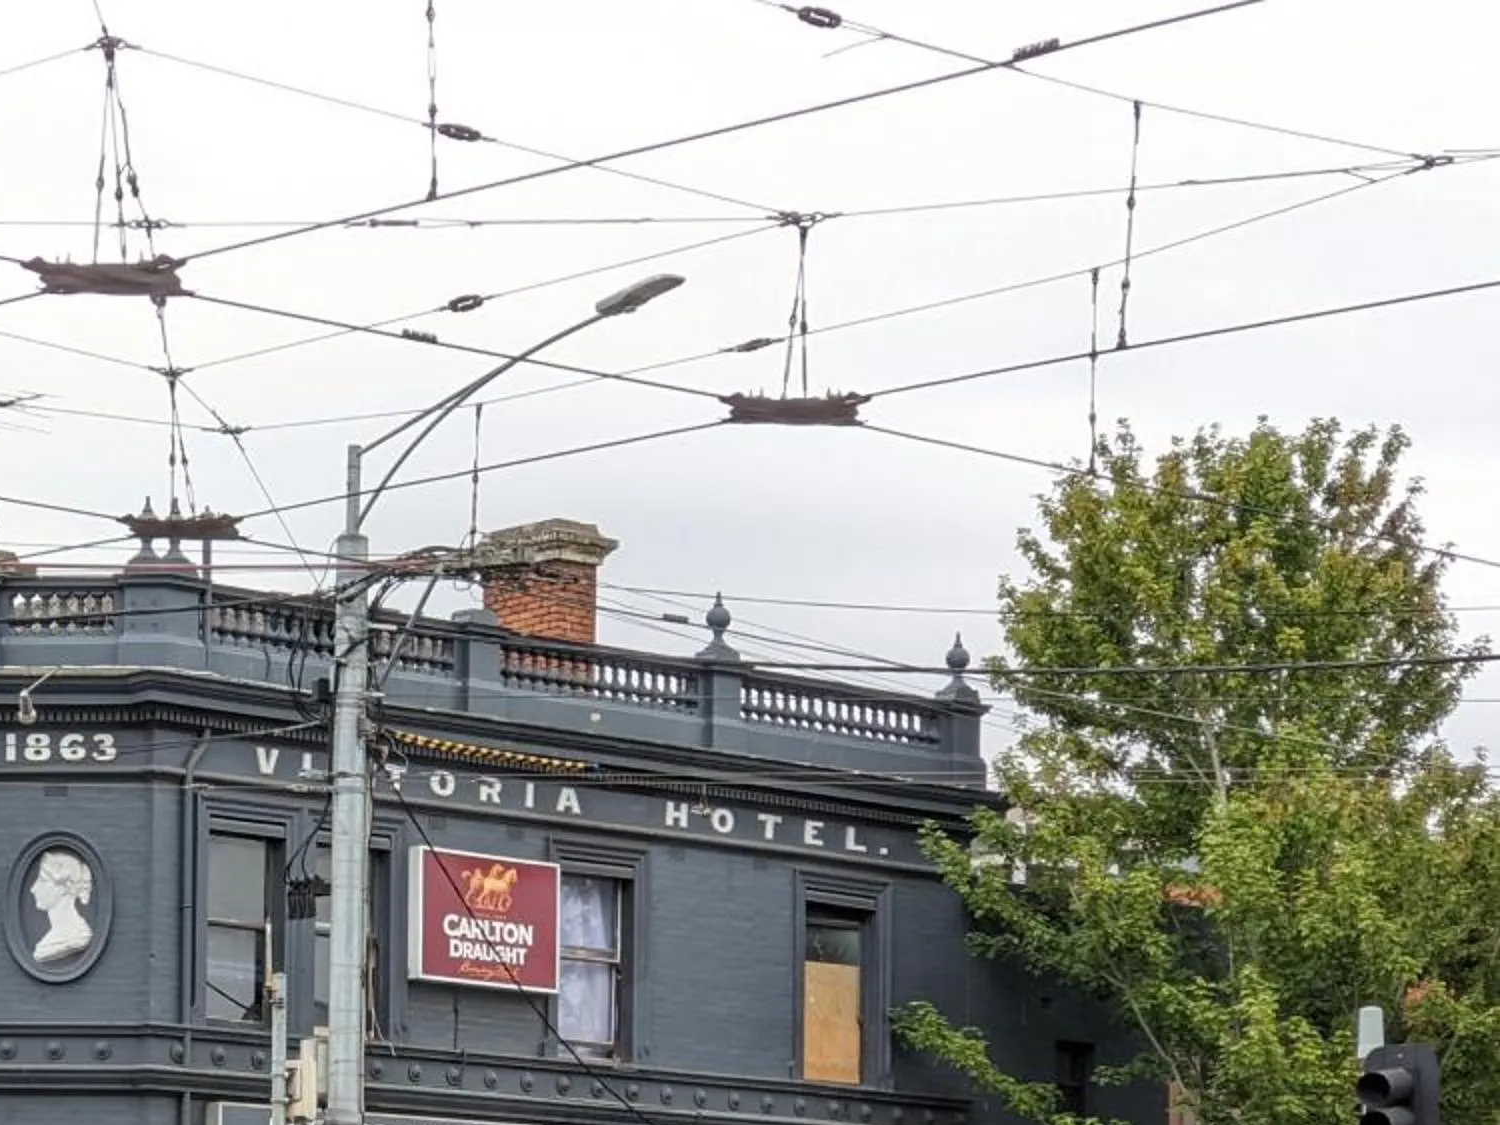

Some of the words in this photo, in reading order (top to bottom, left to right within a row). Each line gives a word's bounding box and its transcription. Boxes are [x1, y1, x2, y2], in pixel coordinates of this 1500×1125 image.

[5, 733, 117, 761] 1863
[256, 746, 581, 816] VITORIA
[664, 801, 889, 856] HOTEL.
[443, 913, 534, 947] CARLTON
[449, 938, 528, 966] DRAUGHT
